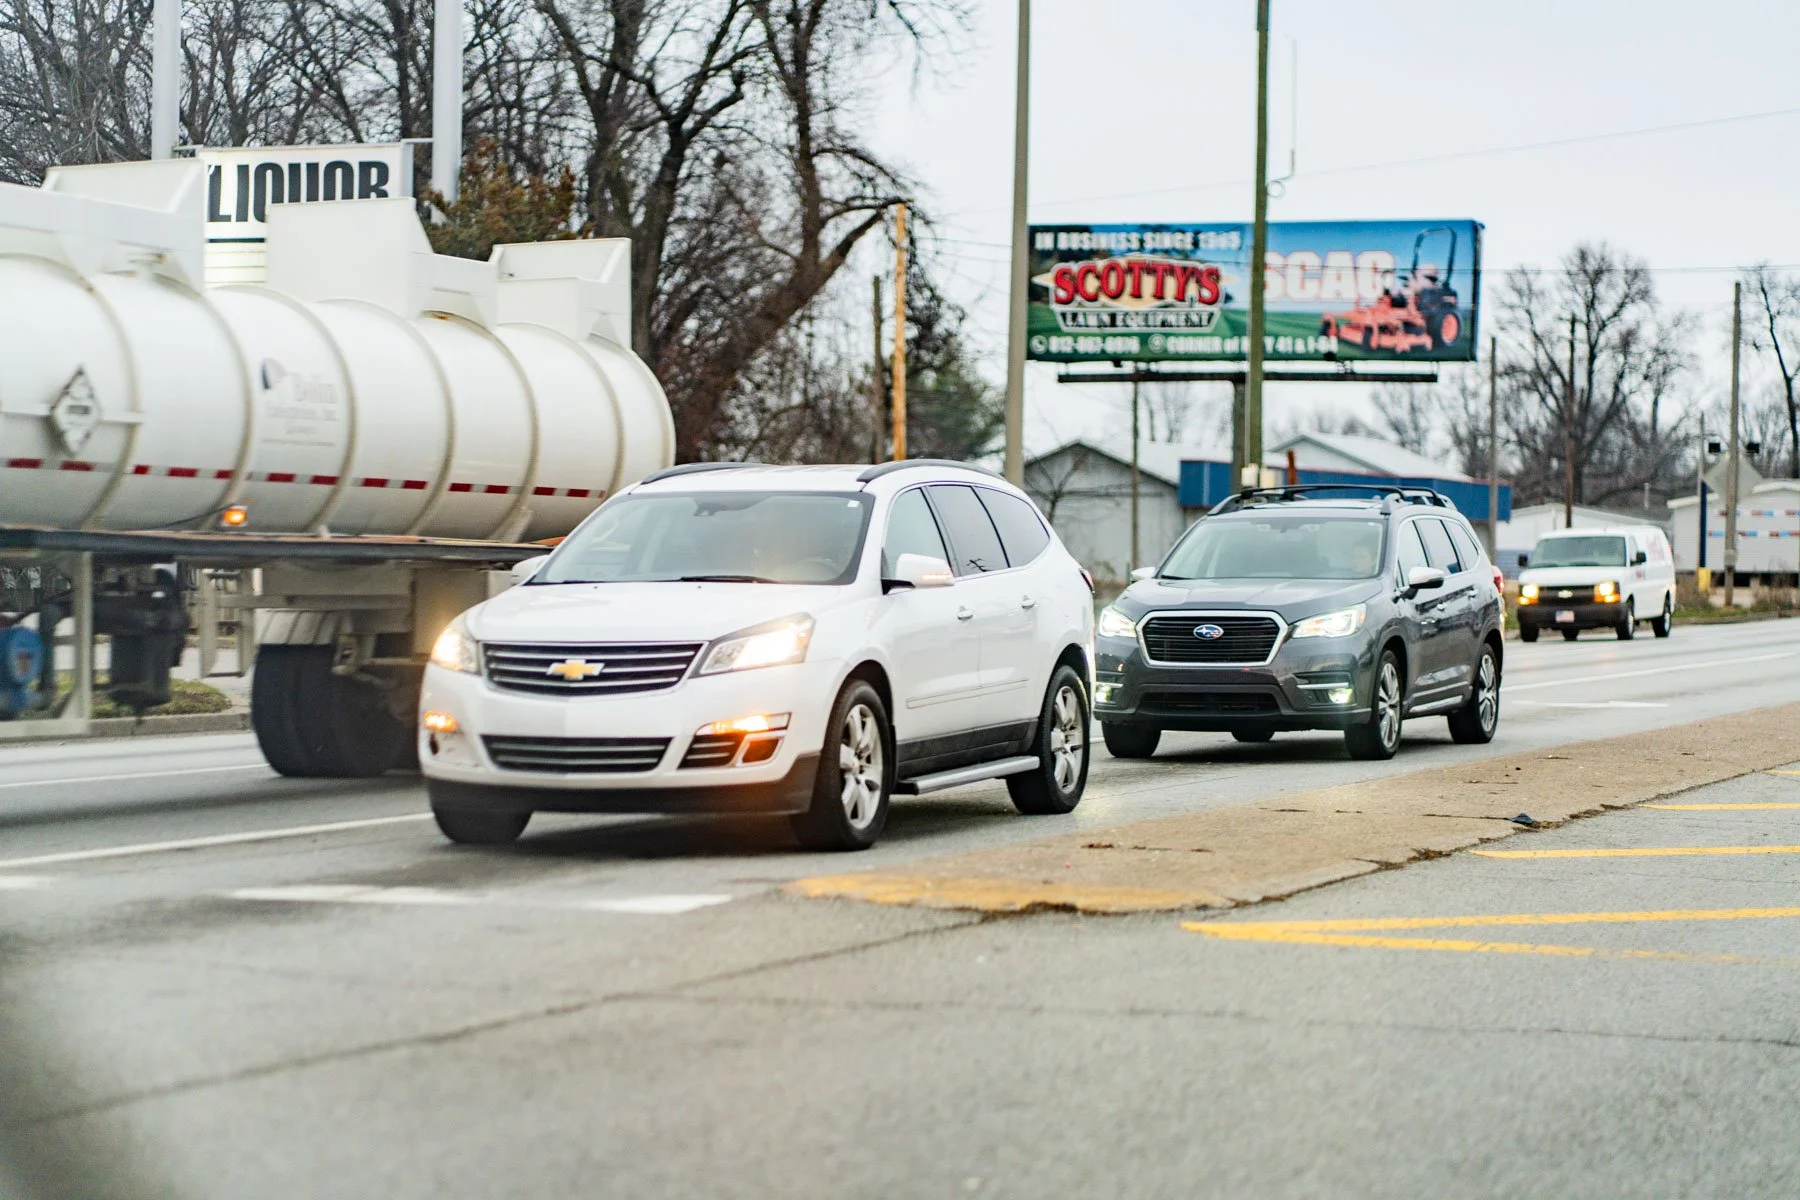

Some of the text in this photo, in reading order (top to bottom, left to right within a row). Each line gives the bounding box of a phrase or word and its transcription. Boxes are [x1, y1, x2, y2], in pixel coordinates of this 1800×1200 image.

[208, 160, 389, 223] LIQUOR
[1057, 231, 1140, 250] BUSINESS
[1143, 231, 1194, 250] SINCE
[1054, 260, 1220, 305] SCOTTY'S
[1065, 311, 1213, 328] LAWN EQUIPMENT
